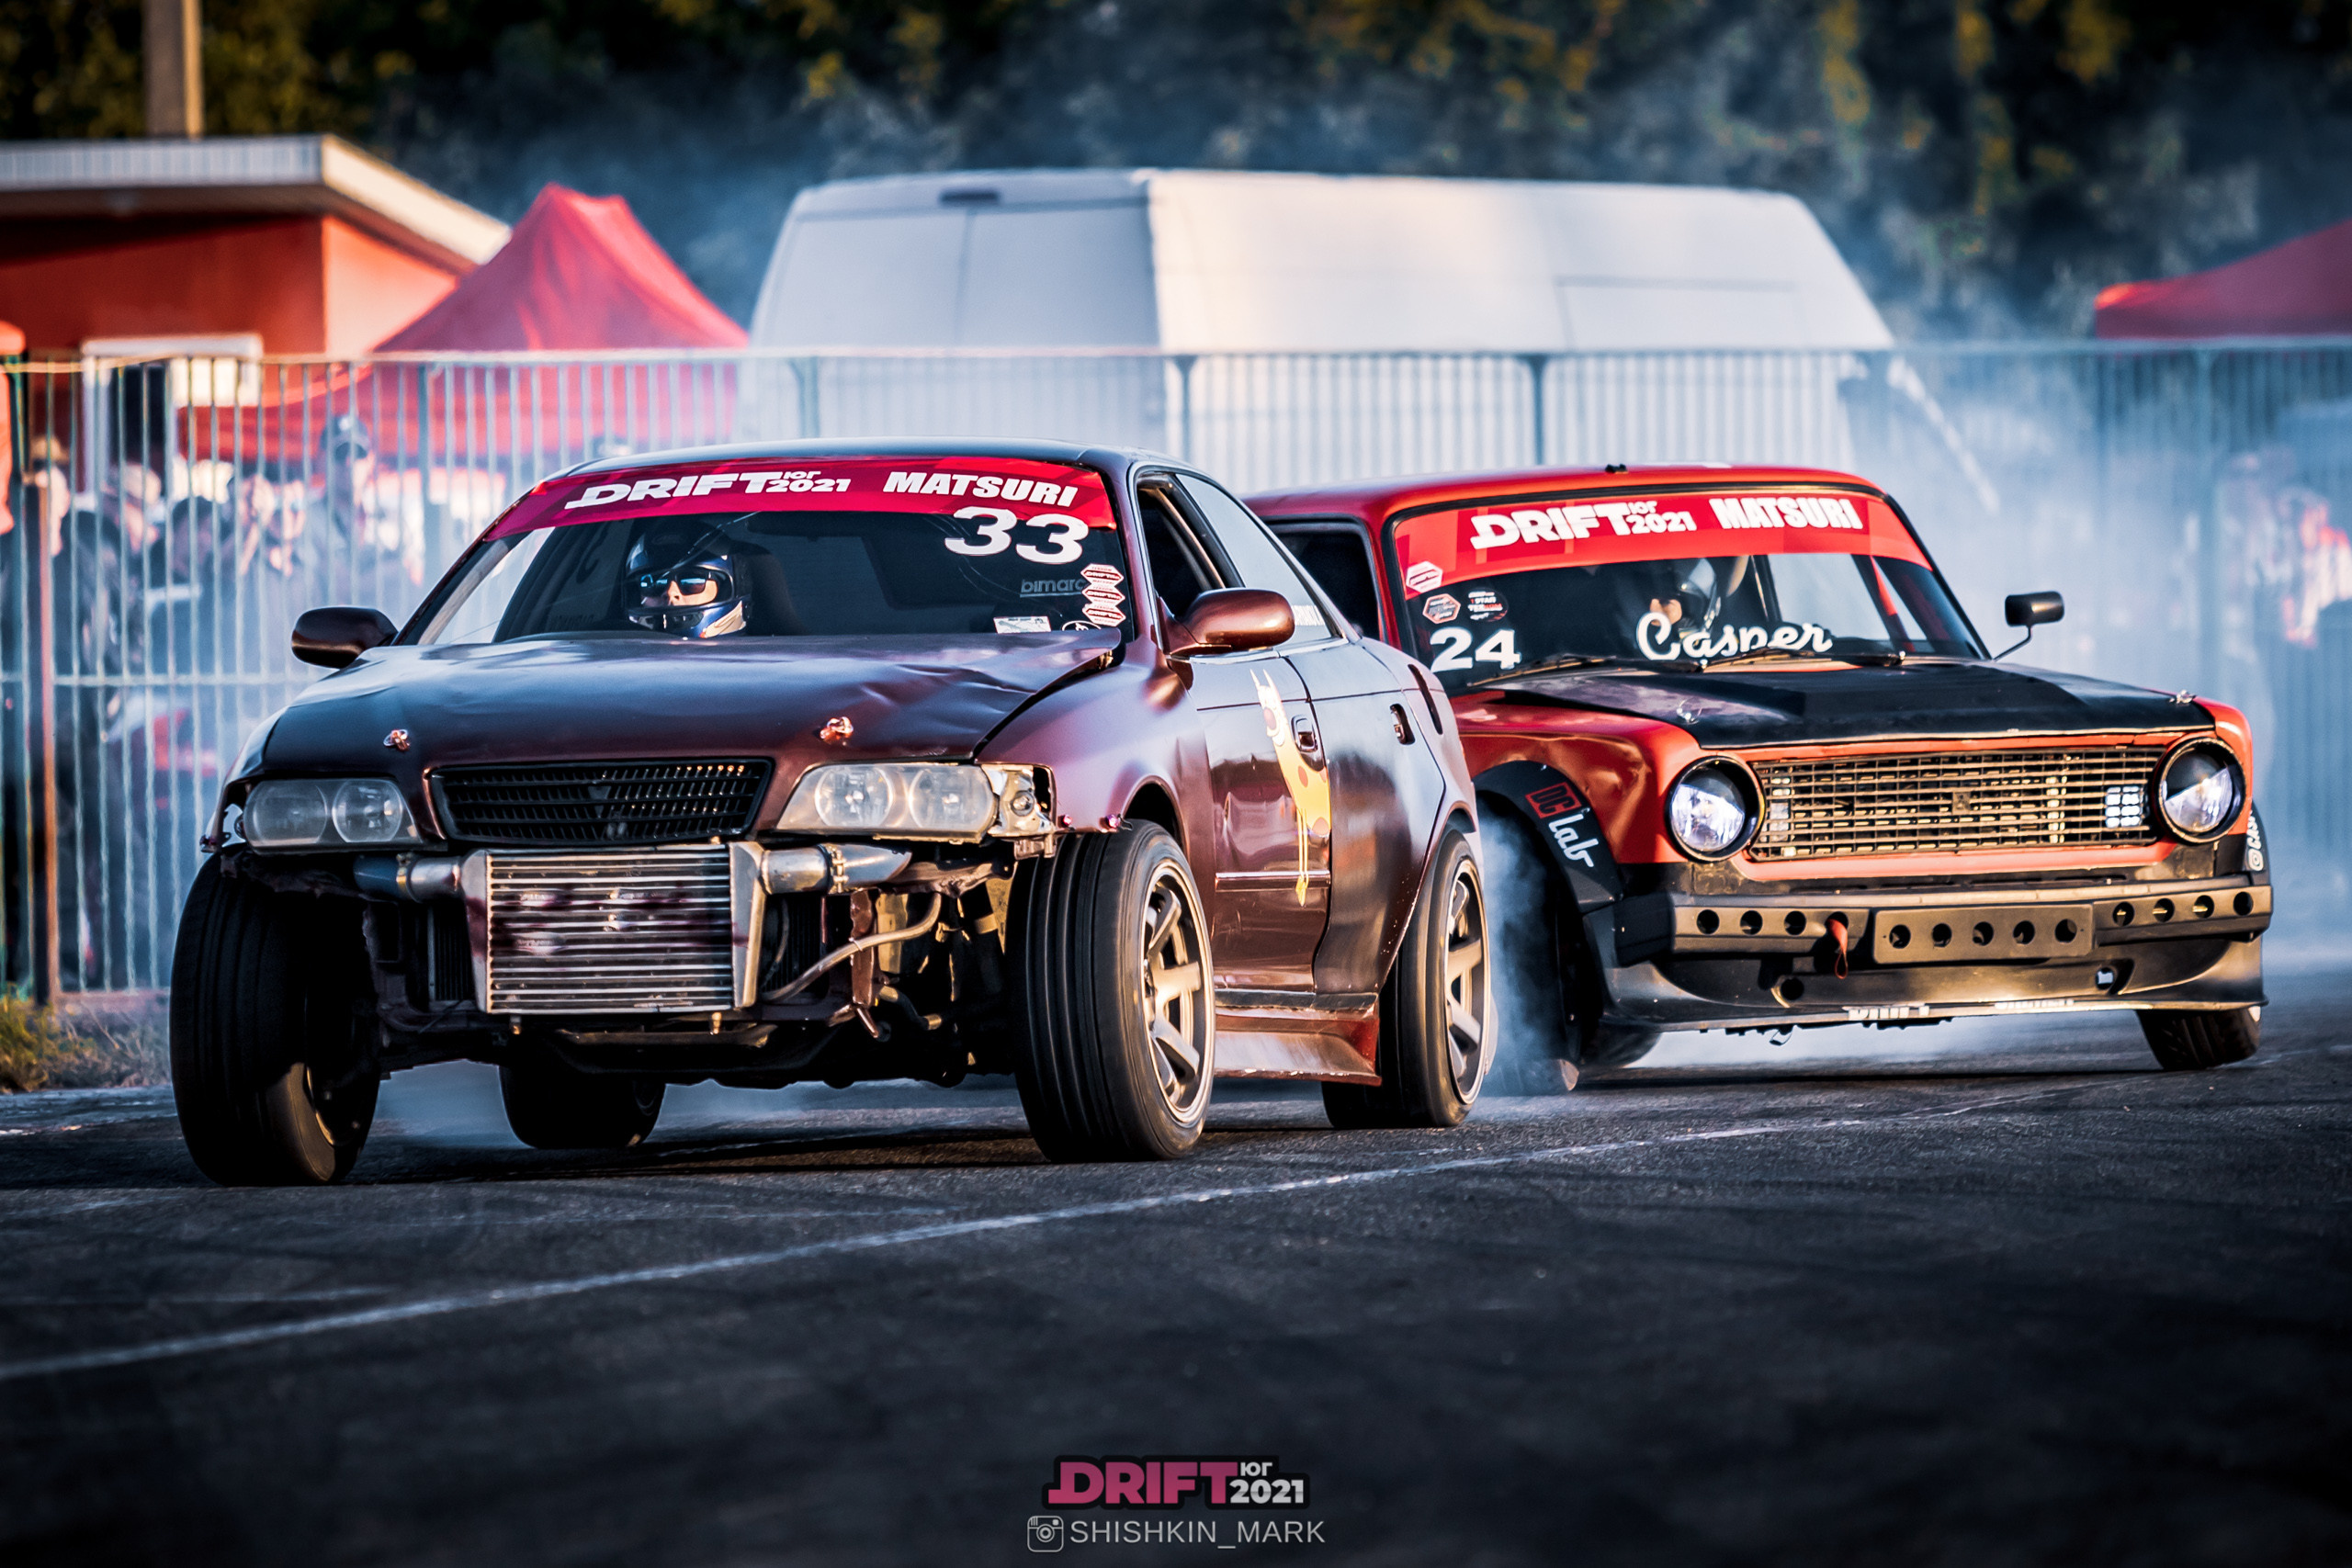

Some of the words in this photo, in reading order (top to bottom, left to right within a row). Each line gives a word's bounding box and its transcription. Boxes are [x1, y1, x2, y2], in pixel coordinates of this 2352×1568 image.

[564, 471, 783, 510] DRIFT
[765, 479, 851, 492] 2021
[883, 471, 1078, 507] MATSURI
[944, 506, 1089, 564] 33
[1470, 502, 1632, 549] DRIFT
[1625, 511, 1697, 534] 2021
[1709, 497, 1863, 529] MATSURI
[1430, 626, 1521, 672] 24
[1636, 611, 1833, 660] Casper
